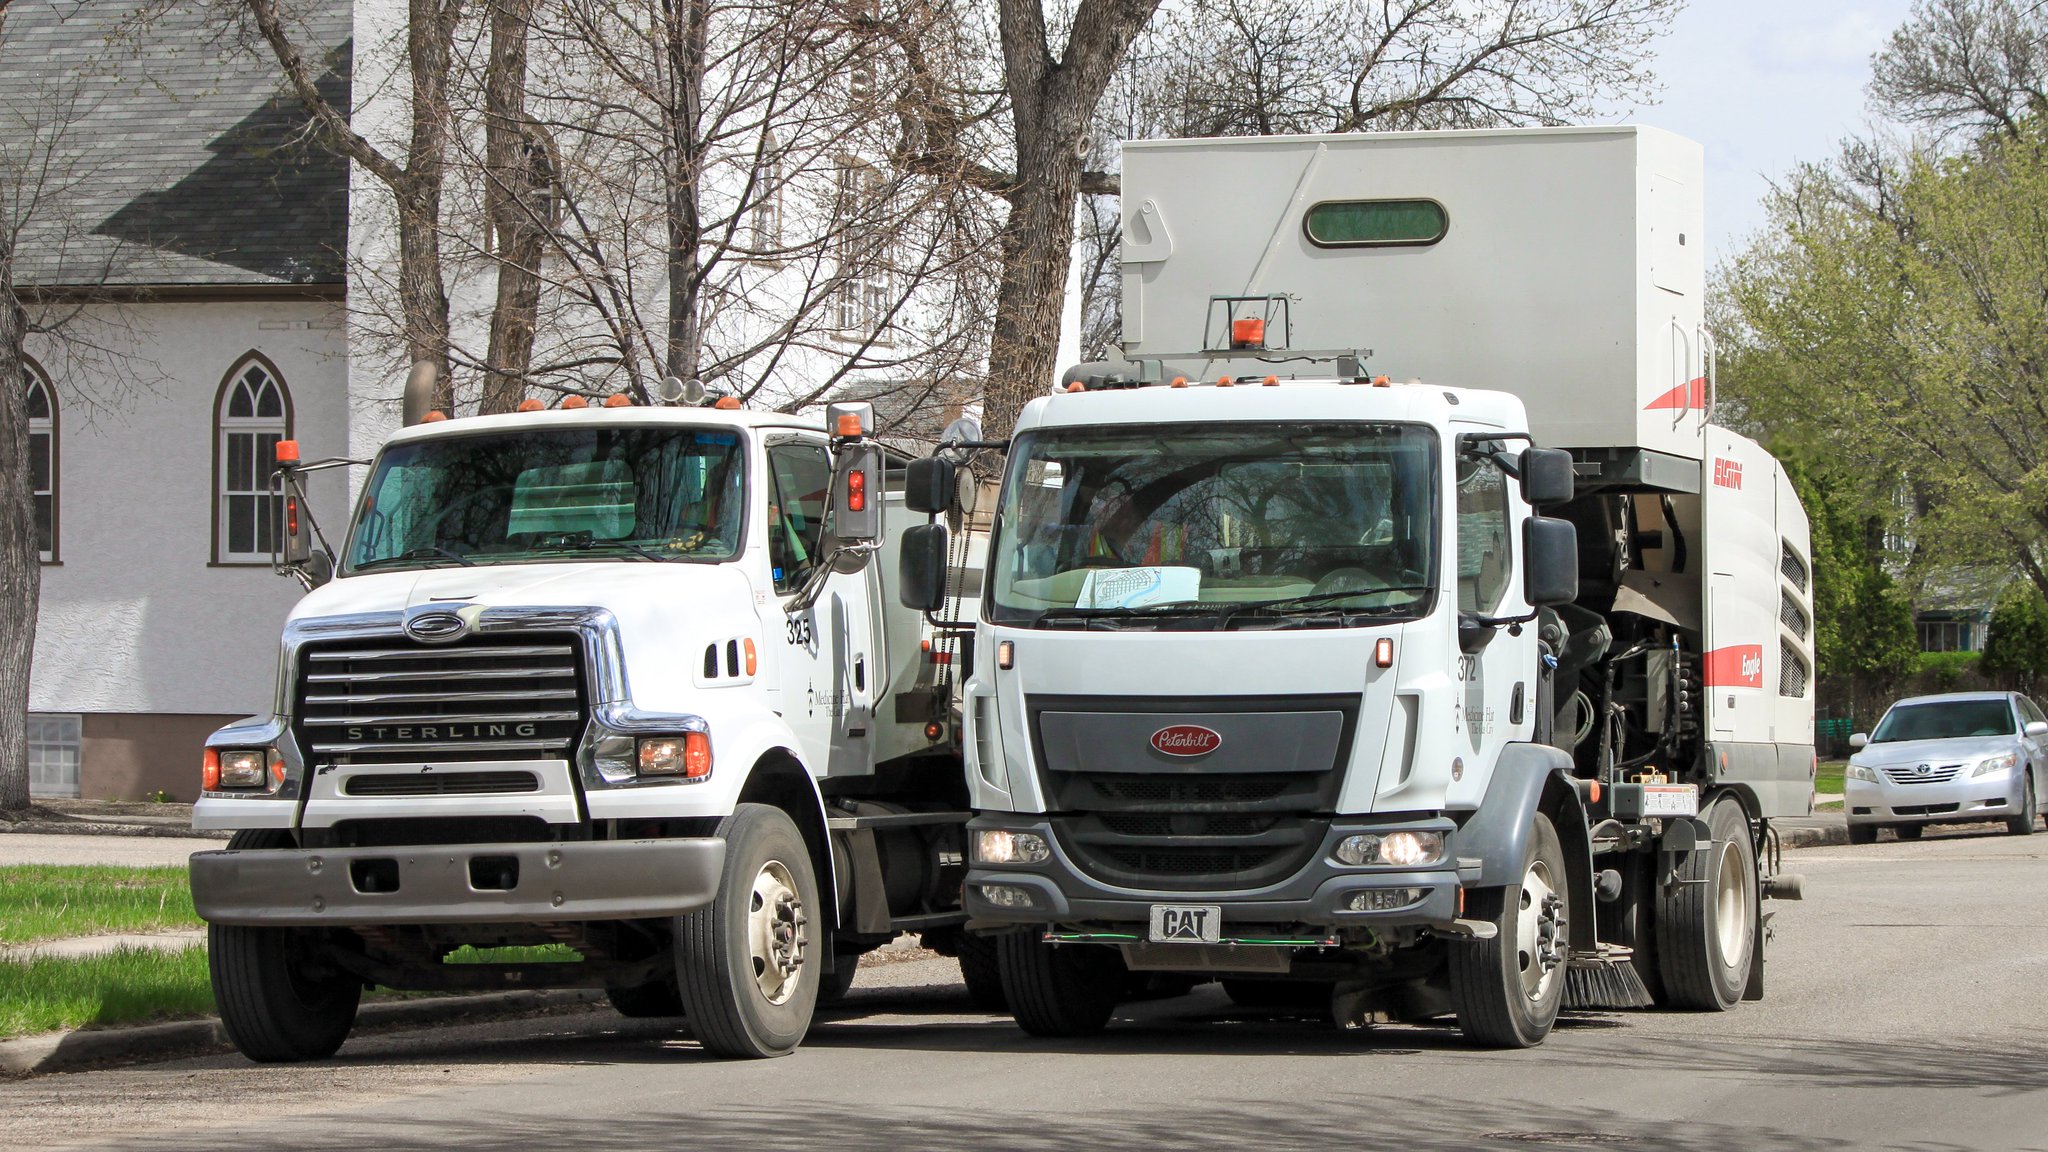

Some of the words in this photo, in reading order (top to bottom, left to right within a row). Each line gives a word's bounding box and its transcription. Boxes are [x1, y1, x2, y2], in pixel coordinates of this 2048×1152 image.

[1714, 457, 1743, 491] ELGIN
[786, 618, 811, 645] 325
[1458, 655, 1476, 682] 372
[1742, 652, 1760, 682] Eagle
[1462, 706, 1484, 722] Medicine
[1485, 706, 1495, 722] Hat
[348, 723, 536, 740] STERLING
[1159, 730, 1214, 748] Peterbilt
[1163, 910, 1207, 941] CAT
